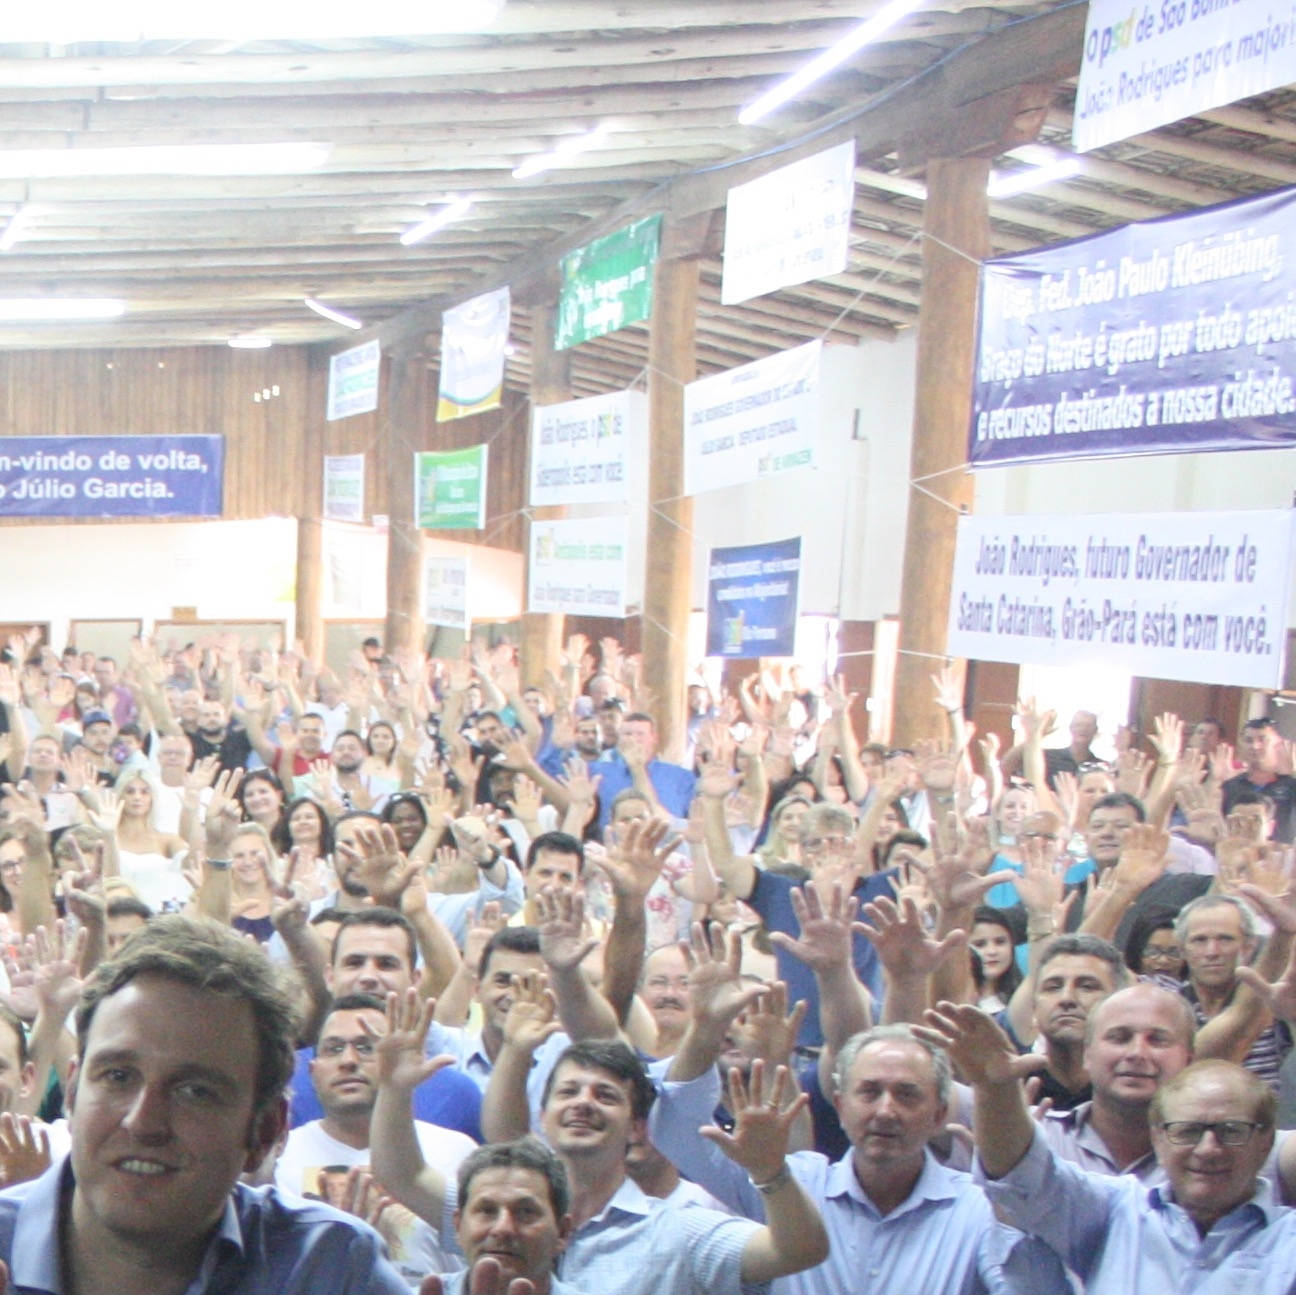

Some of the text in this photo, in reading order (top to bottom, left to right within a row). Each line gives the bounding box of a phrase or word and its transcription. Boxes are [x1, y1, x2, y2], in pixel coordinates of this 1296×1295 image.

[1135, 4, 1156, 44] de
[1079, 79, 1113, 120] João
[1117, 54, 1190, 104] Rodrigues
[1192, 40, 1234, 89] para
[1038, 268, 1072, 313] Fed.
[1074, 259, 1116, 307] João
[1118, 248, 1169, 298] Paulo
[1046, 331, 1092, 373] Norte
[1094, 321, 1106, 367] é
[1108, 320, 1157, 376] grato
[1158, 320, 1193, 369] por
[1195, 302, 1242, 353] todo
[977, 366, 1296, 442] e recursos destinados a nossa cidade.
[11, 475, 77, 501] Júlio
[82, 477, 175, 500] Garcia.
[98, 450, 132, 472] de
[136, 448, 209, 475] volta,
[975, 532, 1259, 588] João Rodrigues, futuro Governador de
[957, 590, 1274, 656] Santa Catarina, Grão-Pará está com você.
